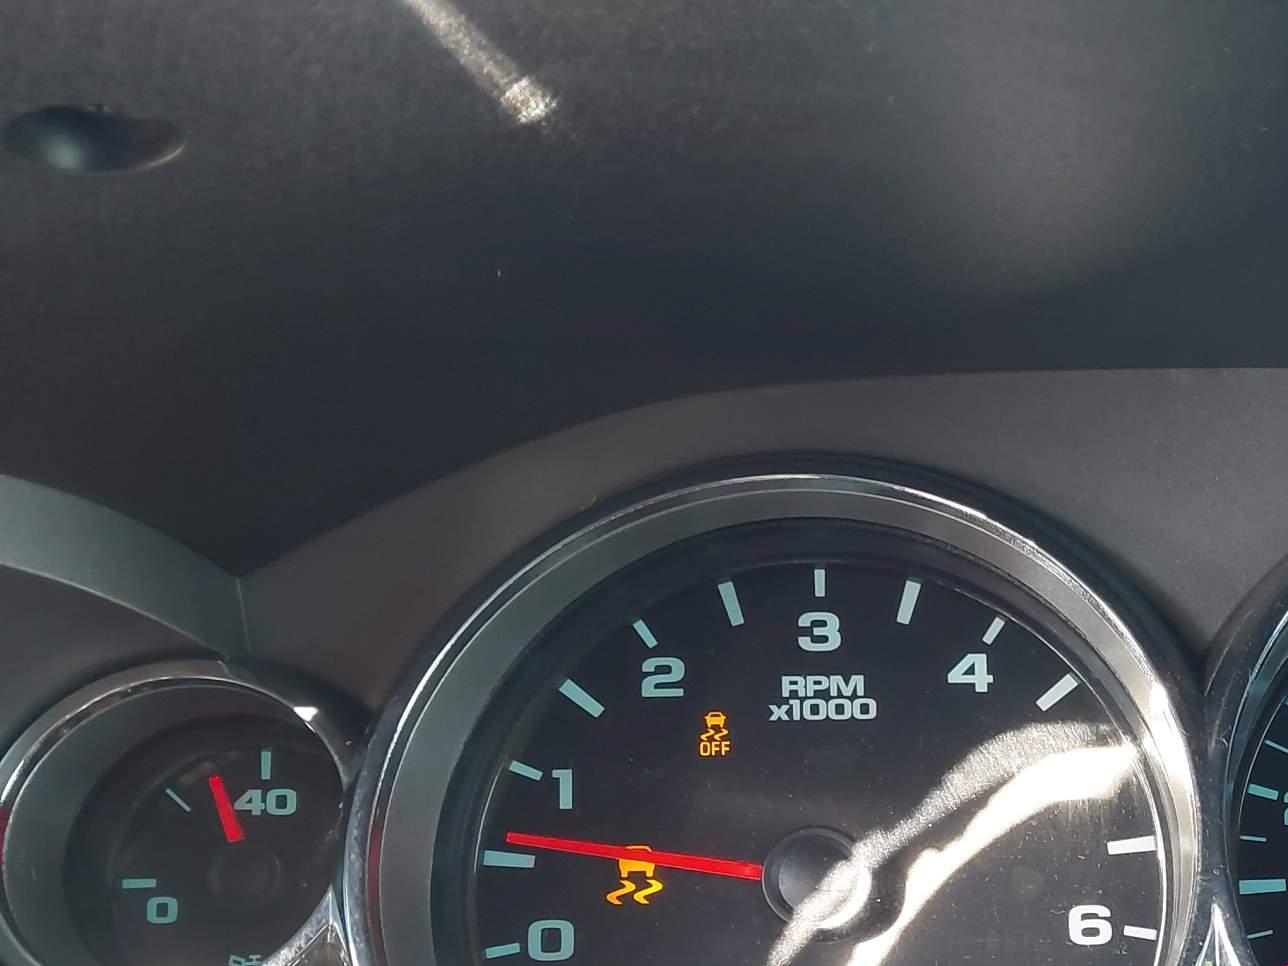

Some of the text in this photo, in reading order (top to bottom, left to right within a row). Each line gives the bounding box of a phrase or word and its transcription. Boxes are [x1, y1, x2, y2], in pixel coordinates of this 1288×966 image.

[797, 612, 842, 652] 3
[641, 656, 686, 698] 2
[781, 674, 865, 698] RPM
[947, 653, 994, 693] 4
[768, 698, 877, 721] x1000
[699, 740, 731, 756] OFF
[233, 787, 298, 817] 40
[551, 768, 574, 810] 1
[146, 896, 178, 925] 0
[1067, 904, 1113, 946] 6
[527, 919, 575, 962] 0
